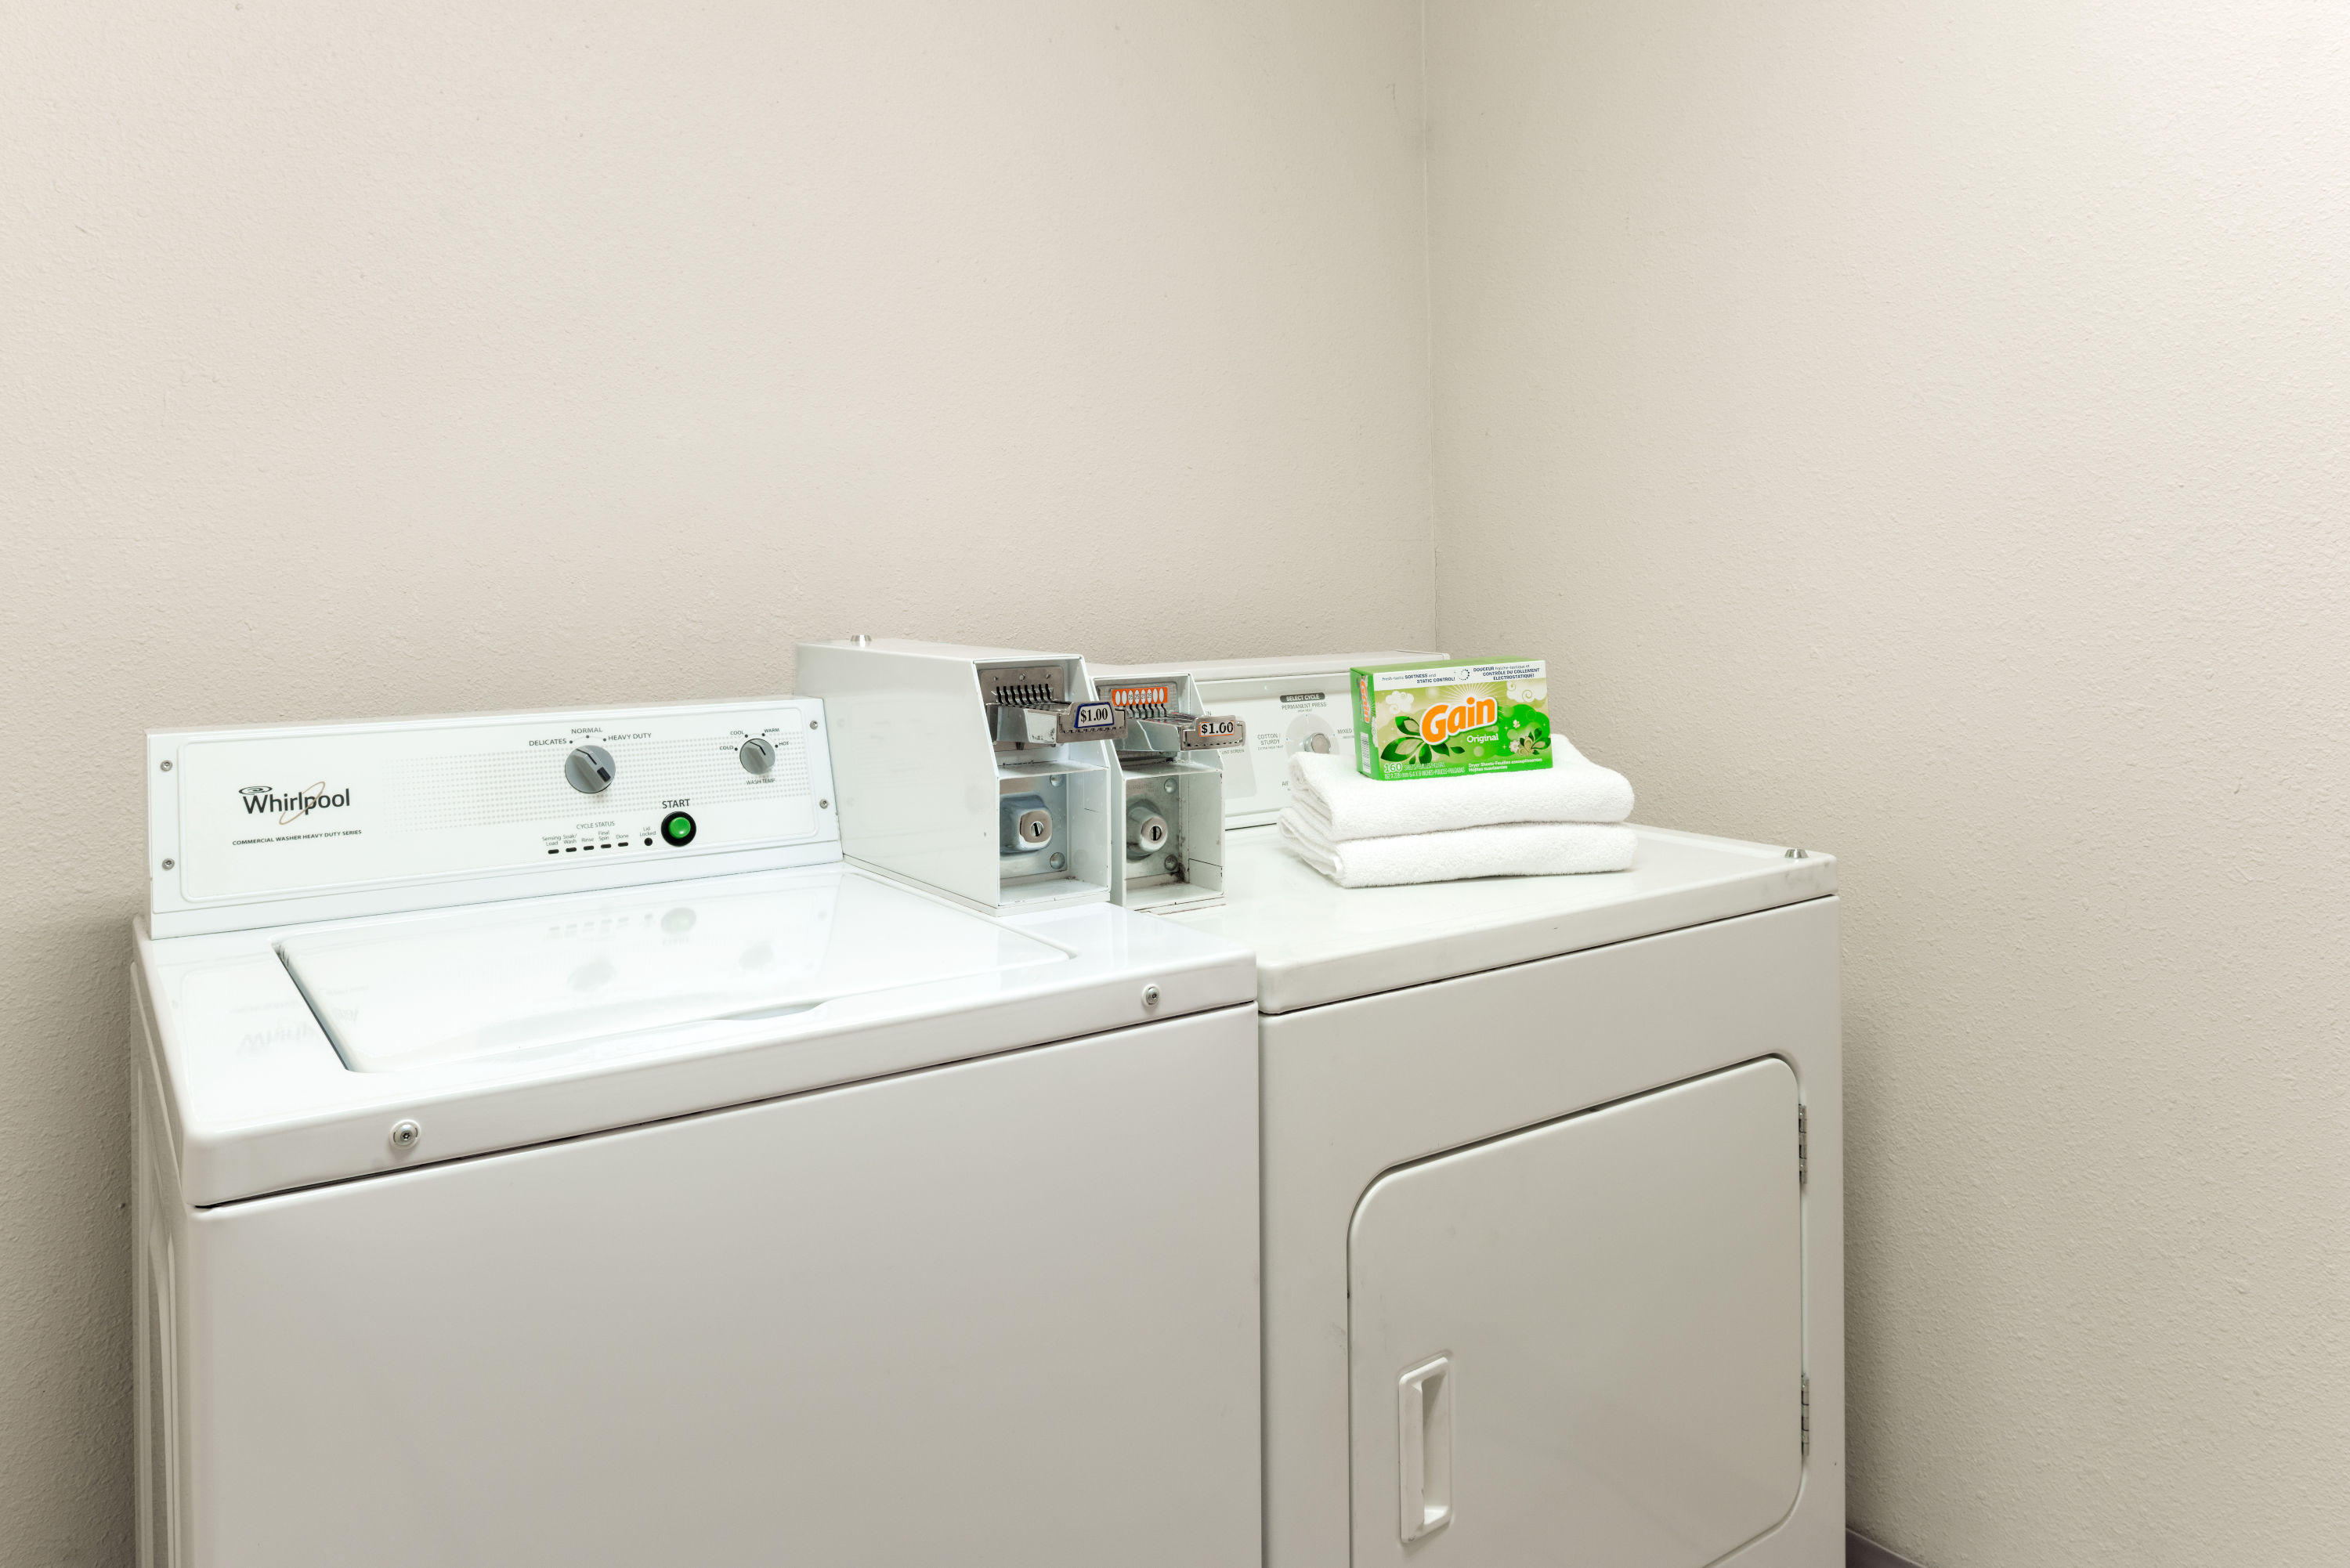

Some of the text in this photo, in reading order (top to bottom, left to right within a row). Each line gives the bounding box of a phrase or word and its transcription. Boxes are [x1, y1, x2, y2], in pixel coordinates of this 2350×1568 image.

[1080, 708, 1108, 723] $1.00
[1421, 696, 1496, 743] Gain
[1201, 721, 1234, 735] $1.00
[529, 738, 567, 746] DELICATES
[1467, 733, 1499, 744] Original
[1384, 762, 1402, 773] 160
[242, 788, 350, 815] Whirlpool
[662, 798, 690, 809] START
[232, 836, 274, 846] COMMERCIAL
